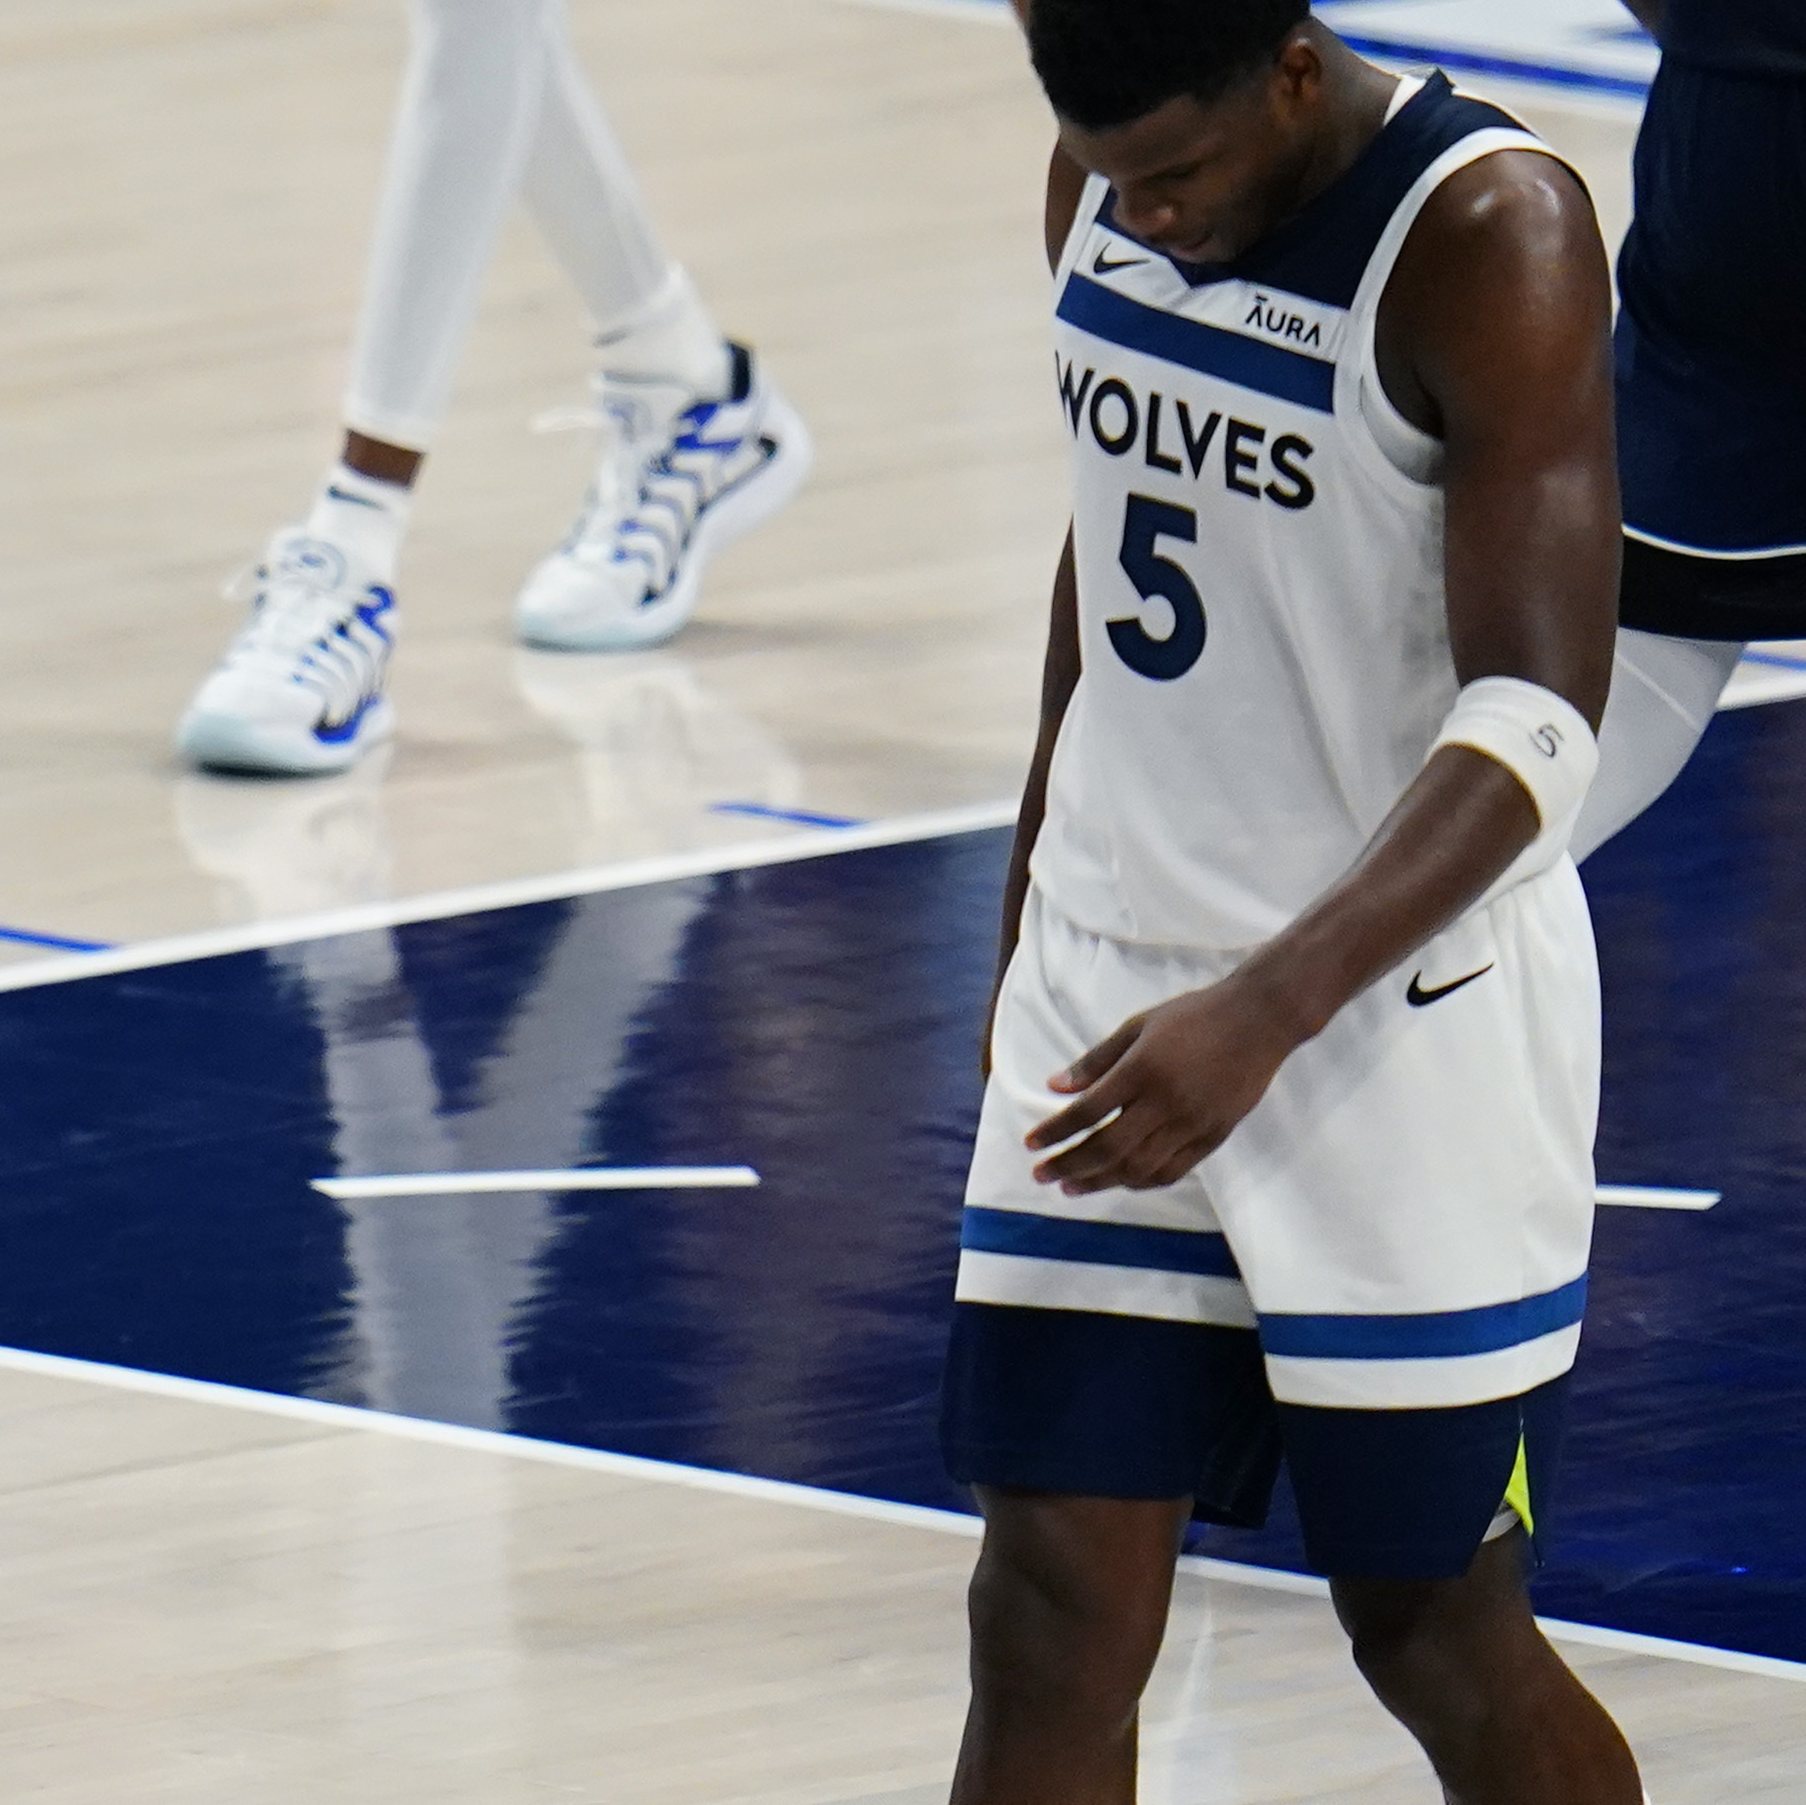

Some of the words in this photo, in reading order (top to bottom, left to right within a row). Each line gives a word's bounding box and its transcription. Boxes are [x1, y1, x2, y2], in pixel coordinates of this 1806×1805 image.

[1055, 349, 1315, 510] WOLVES
[1105, 492, 1207, 682] 5
[1528, 723, 1564, 758] 5
